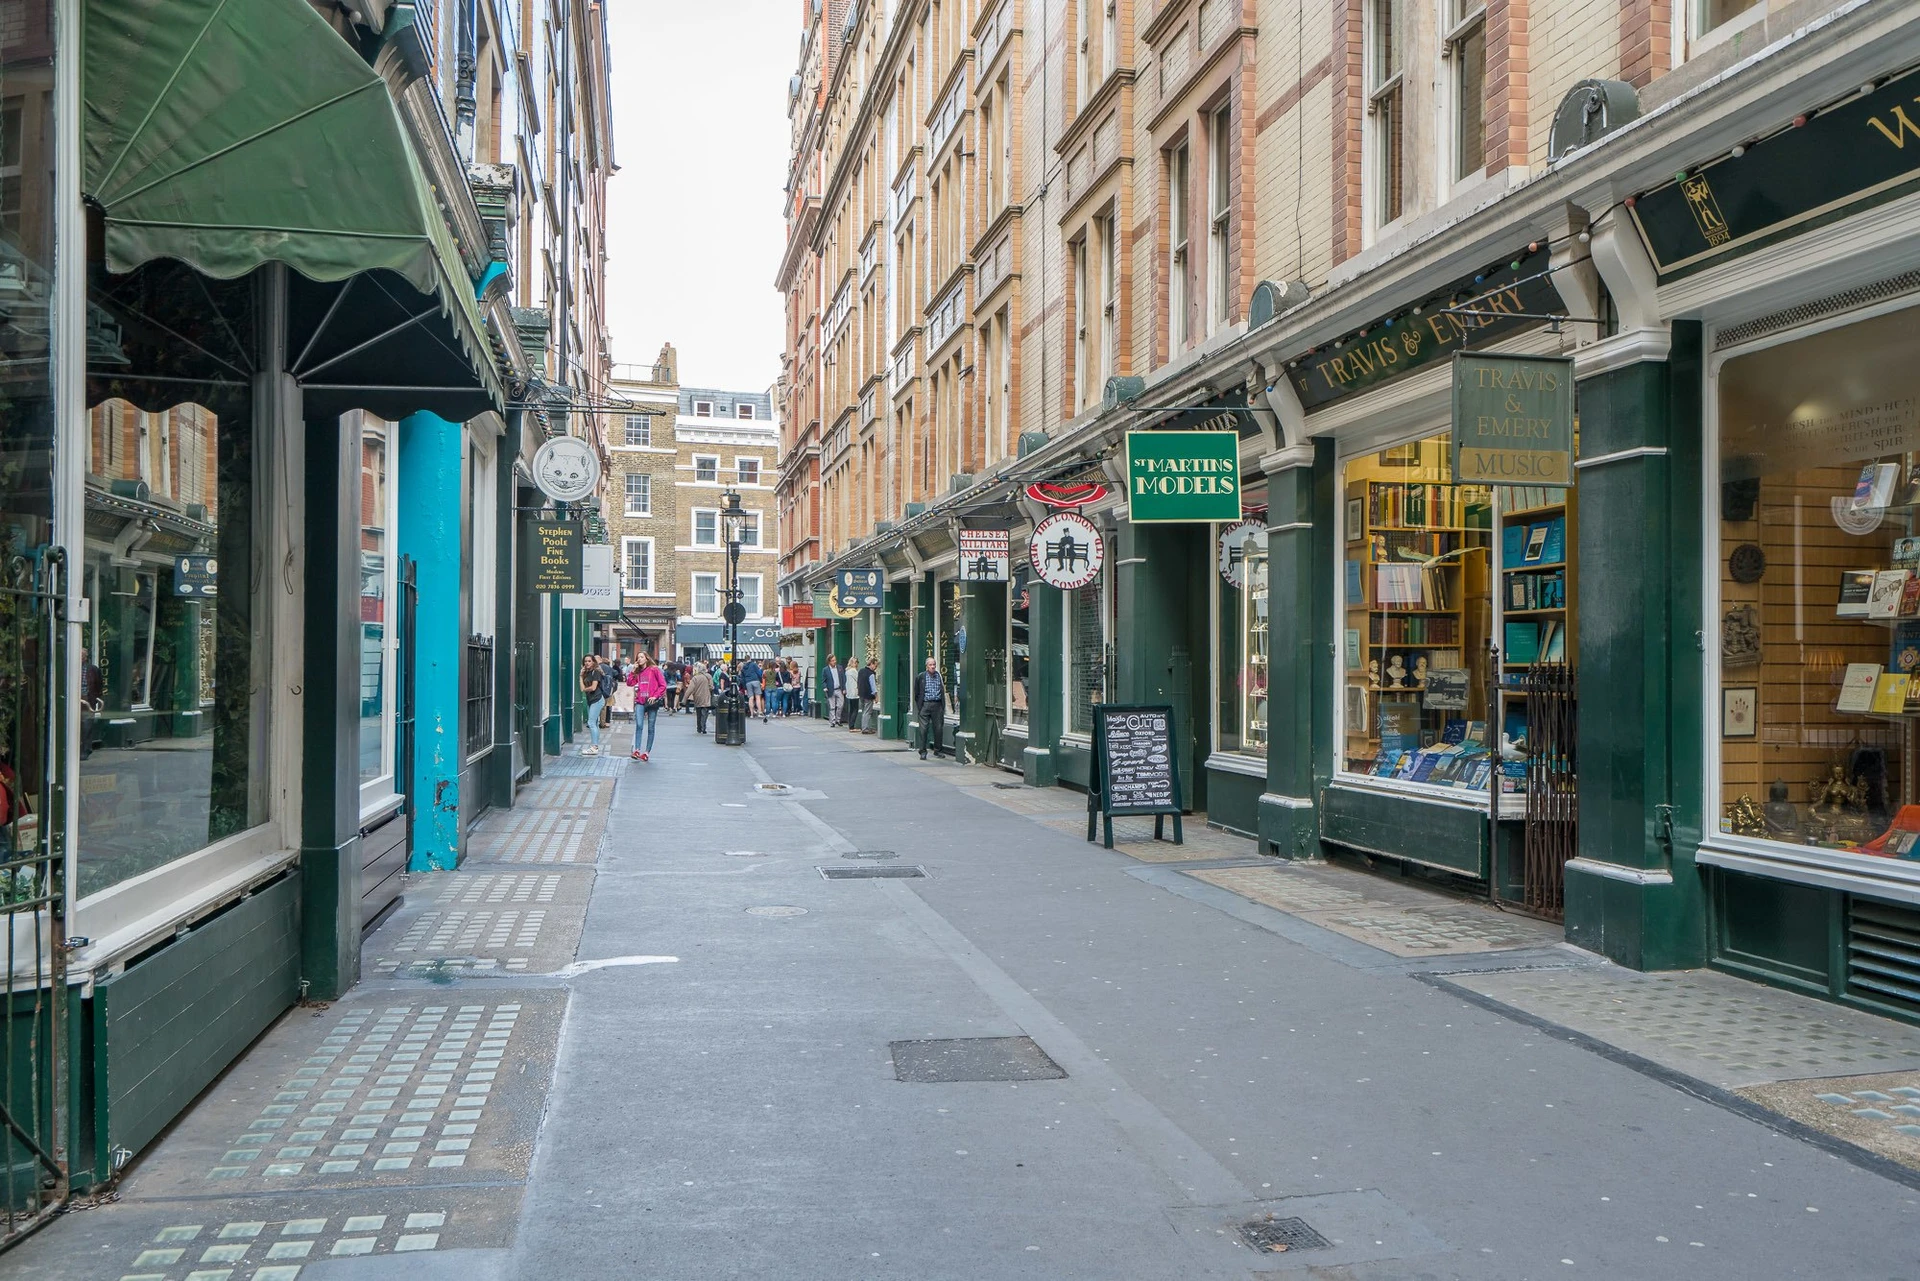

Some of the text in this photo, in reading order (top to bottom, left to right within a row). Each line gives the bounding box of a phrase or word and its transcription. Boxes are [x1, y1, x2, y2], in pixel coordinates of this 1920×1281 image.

[1708, 231, 1731, 247] 1894
[1316, 337, 1398, 388] TRAVIS
[1401, 331, 1421, 356] &
[1426, 277, 1525, 344] EMERY
[1474, 368, 1557, 392] TRAVIS
[1505, 393, 1525, 414] &
[1839, 406, 1874, 420] MIND
[1477, 416, 1552, 438] EMERY
[1873, 436, 1904, 452] SPIR
[1134, 458, 1234, 473] ST MARTINS
[1475, 453, 1554, 477] MUSIC
[1135, 476, 1235, 495] MODELS
[1035, 512, 1095, 536] THE LONDON
[542, 537, 568, 547] Poole
[960, 530, 1009, 539] CHELSEA
[546, 547, 564, 555] Fine
[960, 540, 1009, 549] MILITARY
[540, 556, 569, 565] Books
[961, 550, 1009, 559] ANTQUES
[1030, 538, 1104, 590] MEDAL COMPANY LTD
[582, 588, 611, 596] OOKS
[755, 627, 781, 638] CÔT
